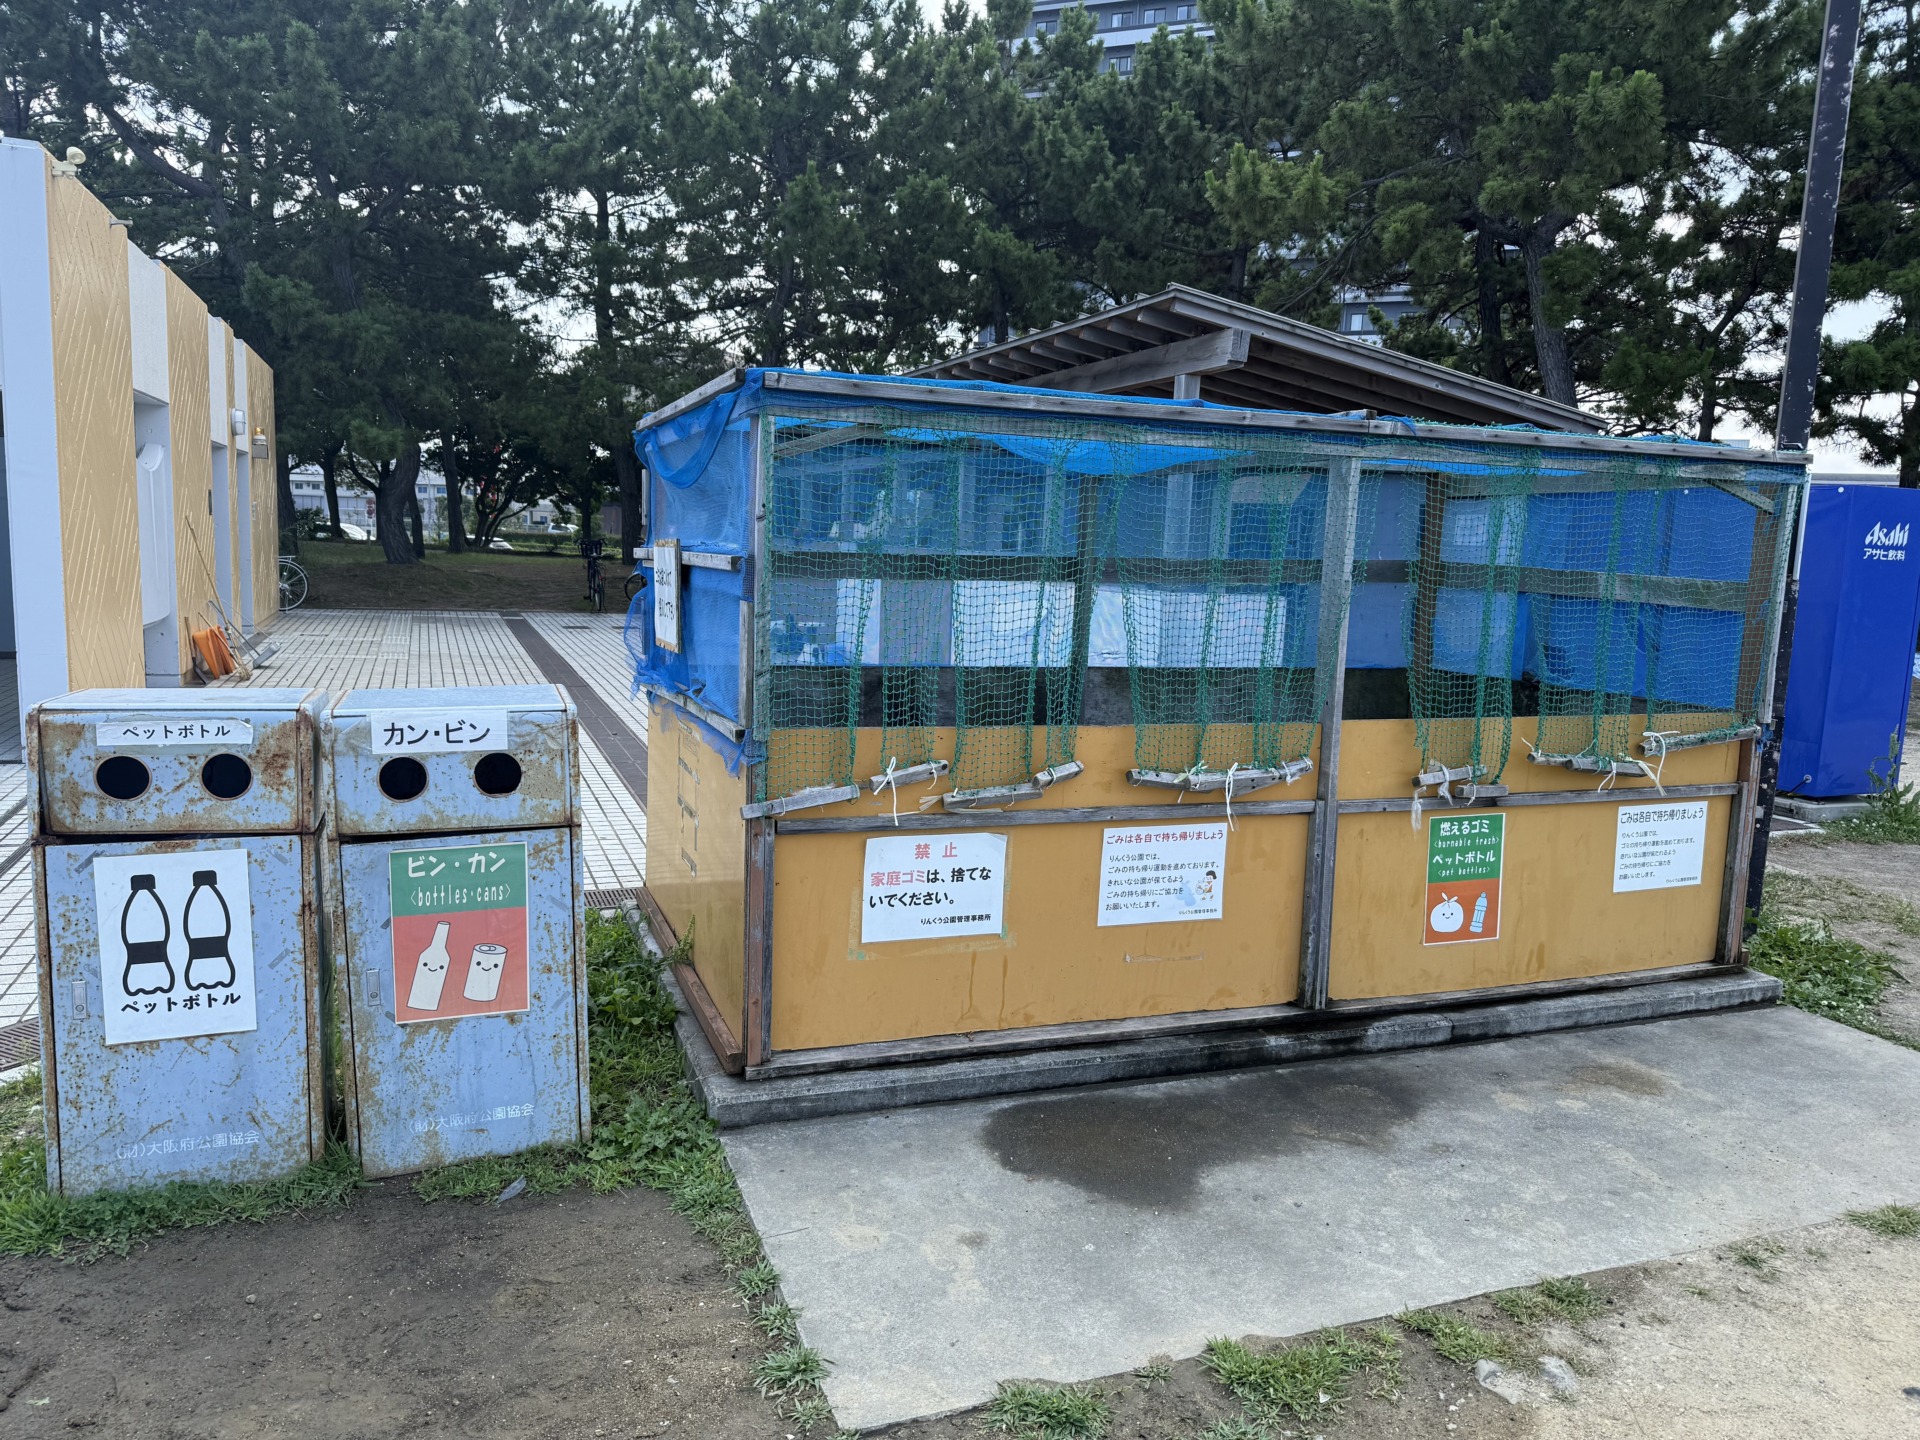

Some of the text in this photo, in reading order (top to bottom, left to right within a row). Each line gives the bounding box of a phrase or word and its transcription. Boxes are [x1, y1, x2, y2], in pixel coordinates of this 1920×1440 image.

[1865, 521, 1909, 547] Asahi
[1863, 548, 1905, 561] アサヒ飲料
[122, 722, 231, 739] ペットボトル
[383, 719, 490, 746] カン・ビン
[1620, 807, 1704, 824] ごみは各自で持ち帰りましょう
[1440, 820, 1489, 836] 燃えるゴミ
[1106, 829, 1224, 845] ごみは各自で持ち帰りましょう
[408, 851, 506, 878] ビン・カン
[1432, 850, 1496, 865] ペットボトル
[1107, 861, 1219, 874] ごみの持ち帰り運動を進めております。
[870, 867, 992, 887] 家庭ゴミは、捨てな
[869, 891, 955, 908] いでください。
[1106, 887, 1184, 899] ごみの持ち帰りにご協力を
[920, 913, 991, 925] りんくう公園管理事務所
[120, 992, 242, 1014] ペットボトル
